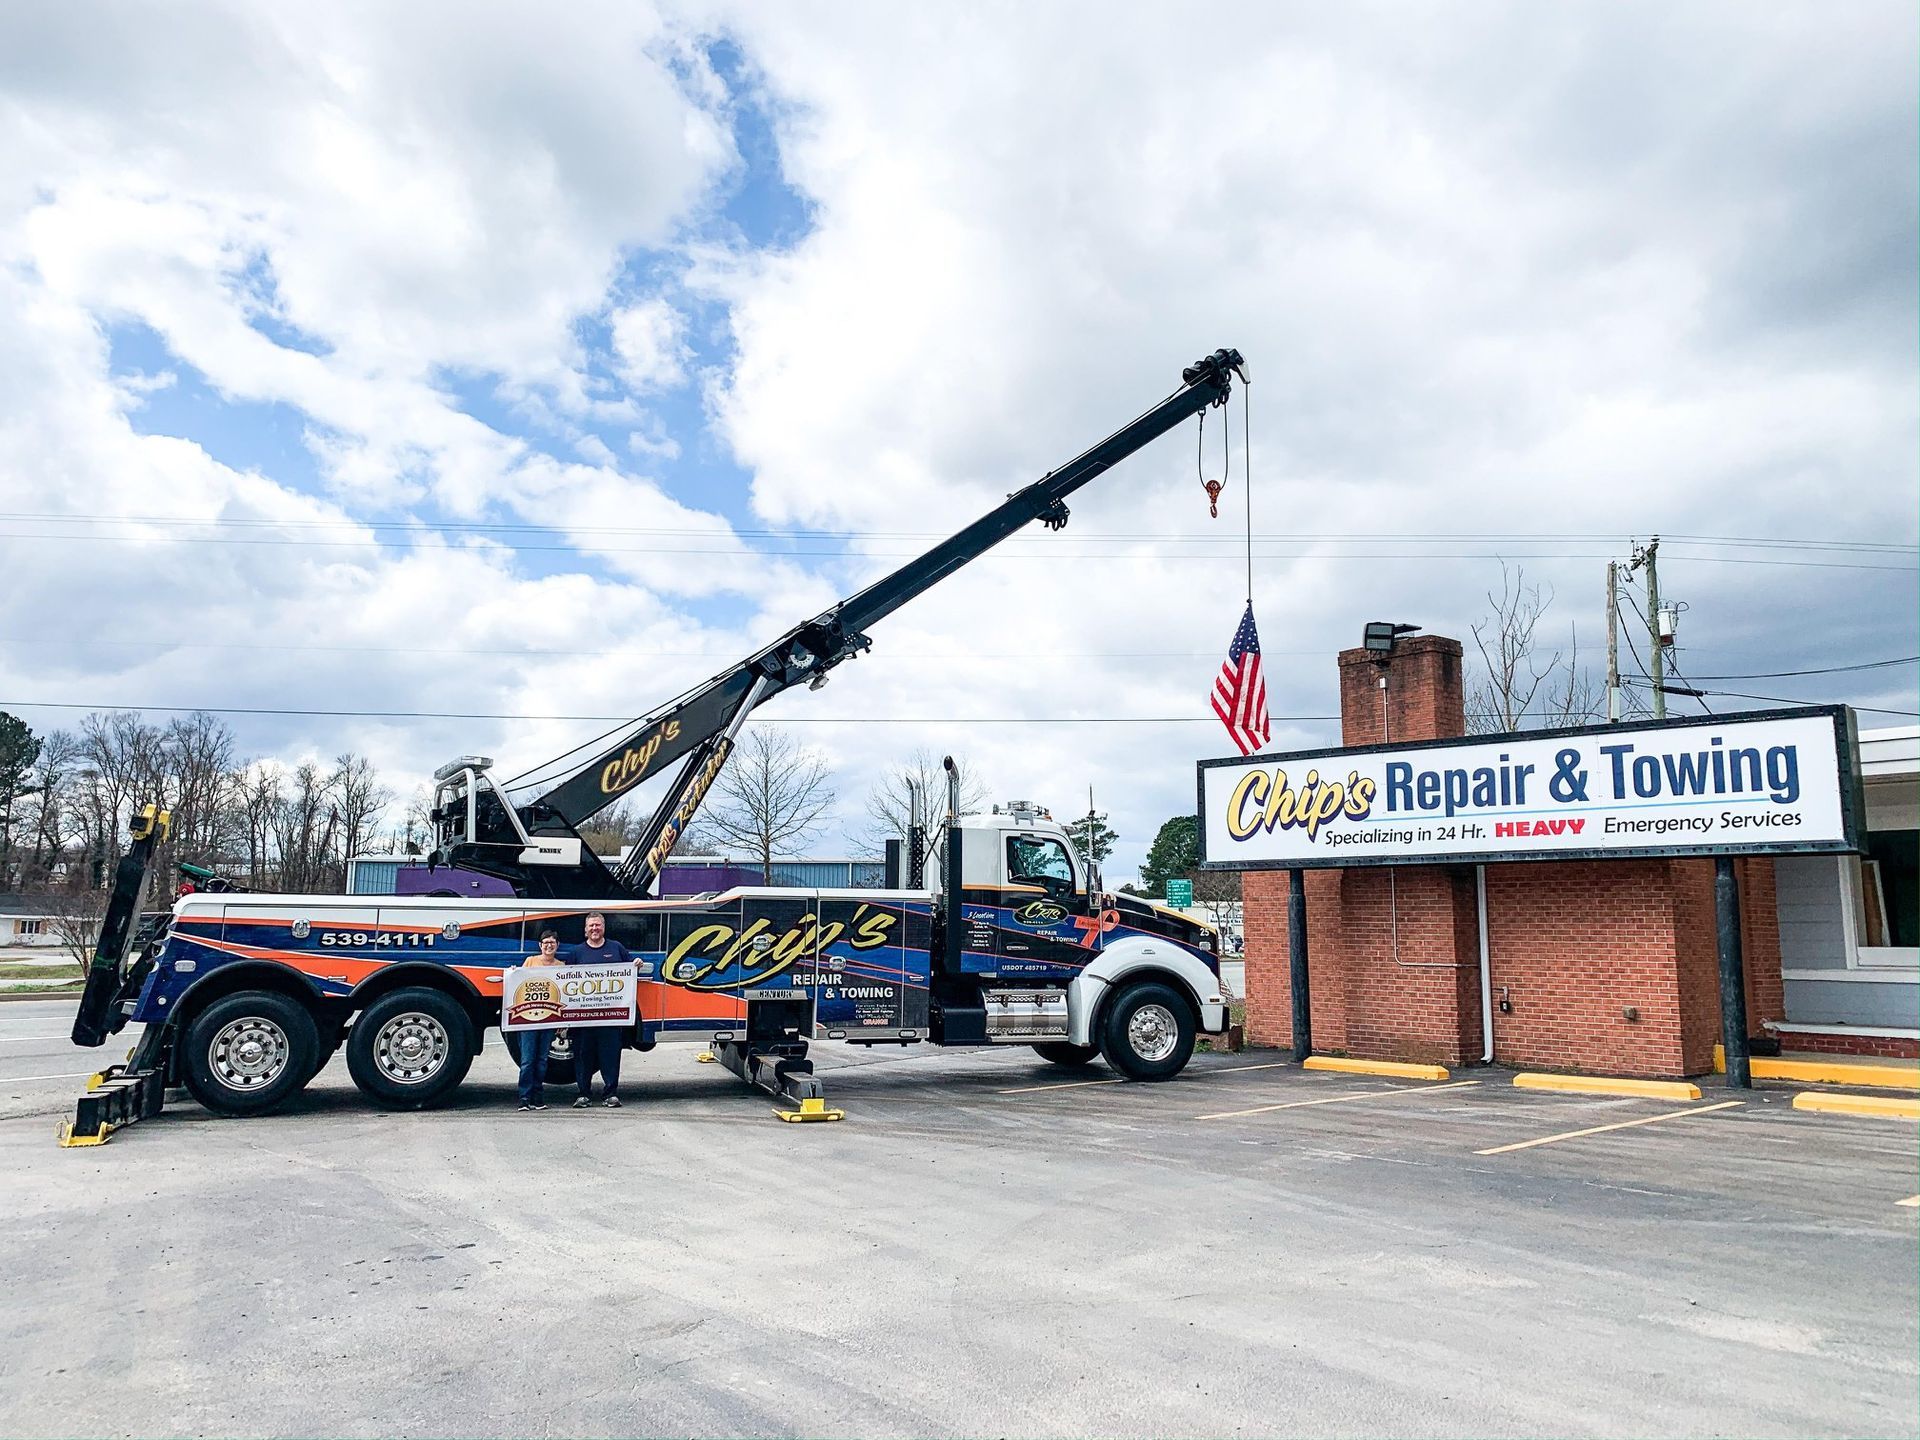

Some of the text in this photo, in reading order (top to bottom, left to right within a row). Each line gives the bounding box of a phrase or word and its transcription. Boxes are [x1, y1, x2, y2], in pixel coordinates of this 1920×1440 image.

[601, 721, 681, 793] Chip's
[1227, 737, 1800, 843] Chip's Repair & Towing
[1325, 811, 1802, 847] Specializing in 24 Hr. HEAVY Emergency Services
[1025, 902, 1061, 920] CRTS
[1200, 928, 1210, 937] 25
[321, 932, 436, 947] 539-4111
[661, 904, 897, 989] Chip's
[556, 969, 632, 980] Suffolk News-Herald
[793, 974, 842, 985] REPAIR
[562, 979, 624, 996] GOLD
[759, 990, 794, 998] CENTURY
[825, 987, 894, 998] & TOWING
[524, 993, 550, 1001] 2019
[863, 1018, 889, 1026] ORANGE
